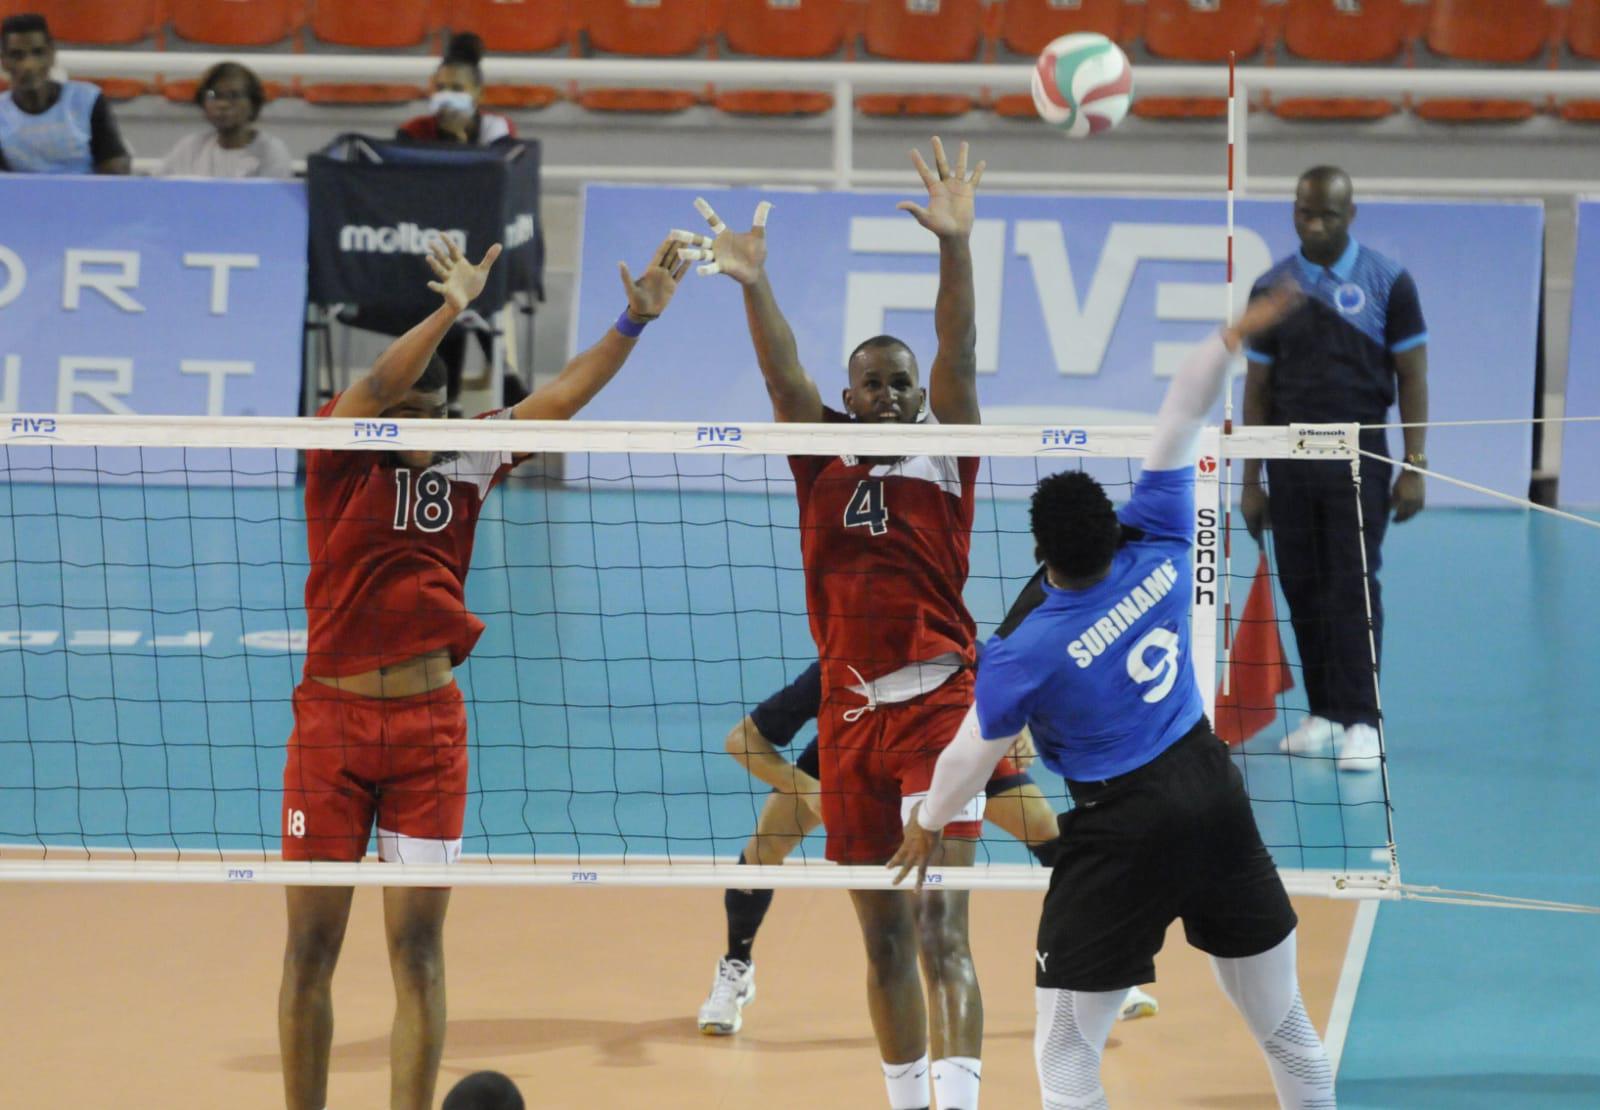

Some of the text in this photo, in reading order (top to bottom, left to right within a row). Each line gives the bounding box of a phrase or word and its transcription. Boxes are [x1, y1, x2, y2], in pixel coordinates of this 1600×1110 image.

[843, 216, 1273, 378] FIVB
[0, 354, 255, 416] RT
[11, 418, 56, 432] FIVB
[354, 423, 398, 437] FIVB
[697, 426, 742, 441] FIVB
[1042, 429, 1088, 444] FIVB
[393, 468, 453, 533] 18
[844, 480, 888, 536] 4
[1196, 508, 1216, 605] Senoh
[1067, 558, 1179, 669] SURINAME
[1126, 627, 1179, 703] 9
[288, 808, 306, 838] 18
[228, 869, 254, 878] FIVB
[572, 872, 597, 880] FIVB
